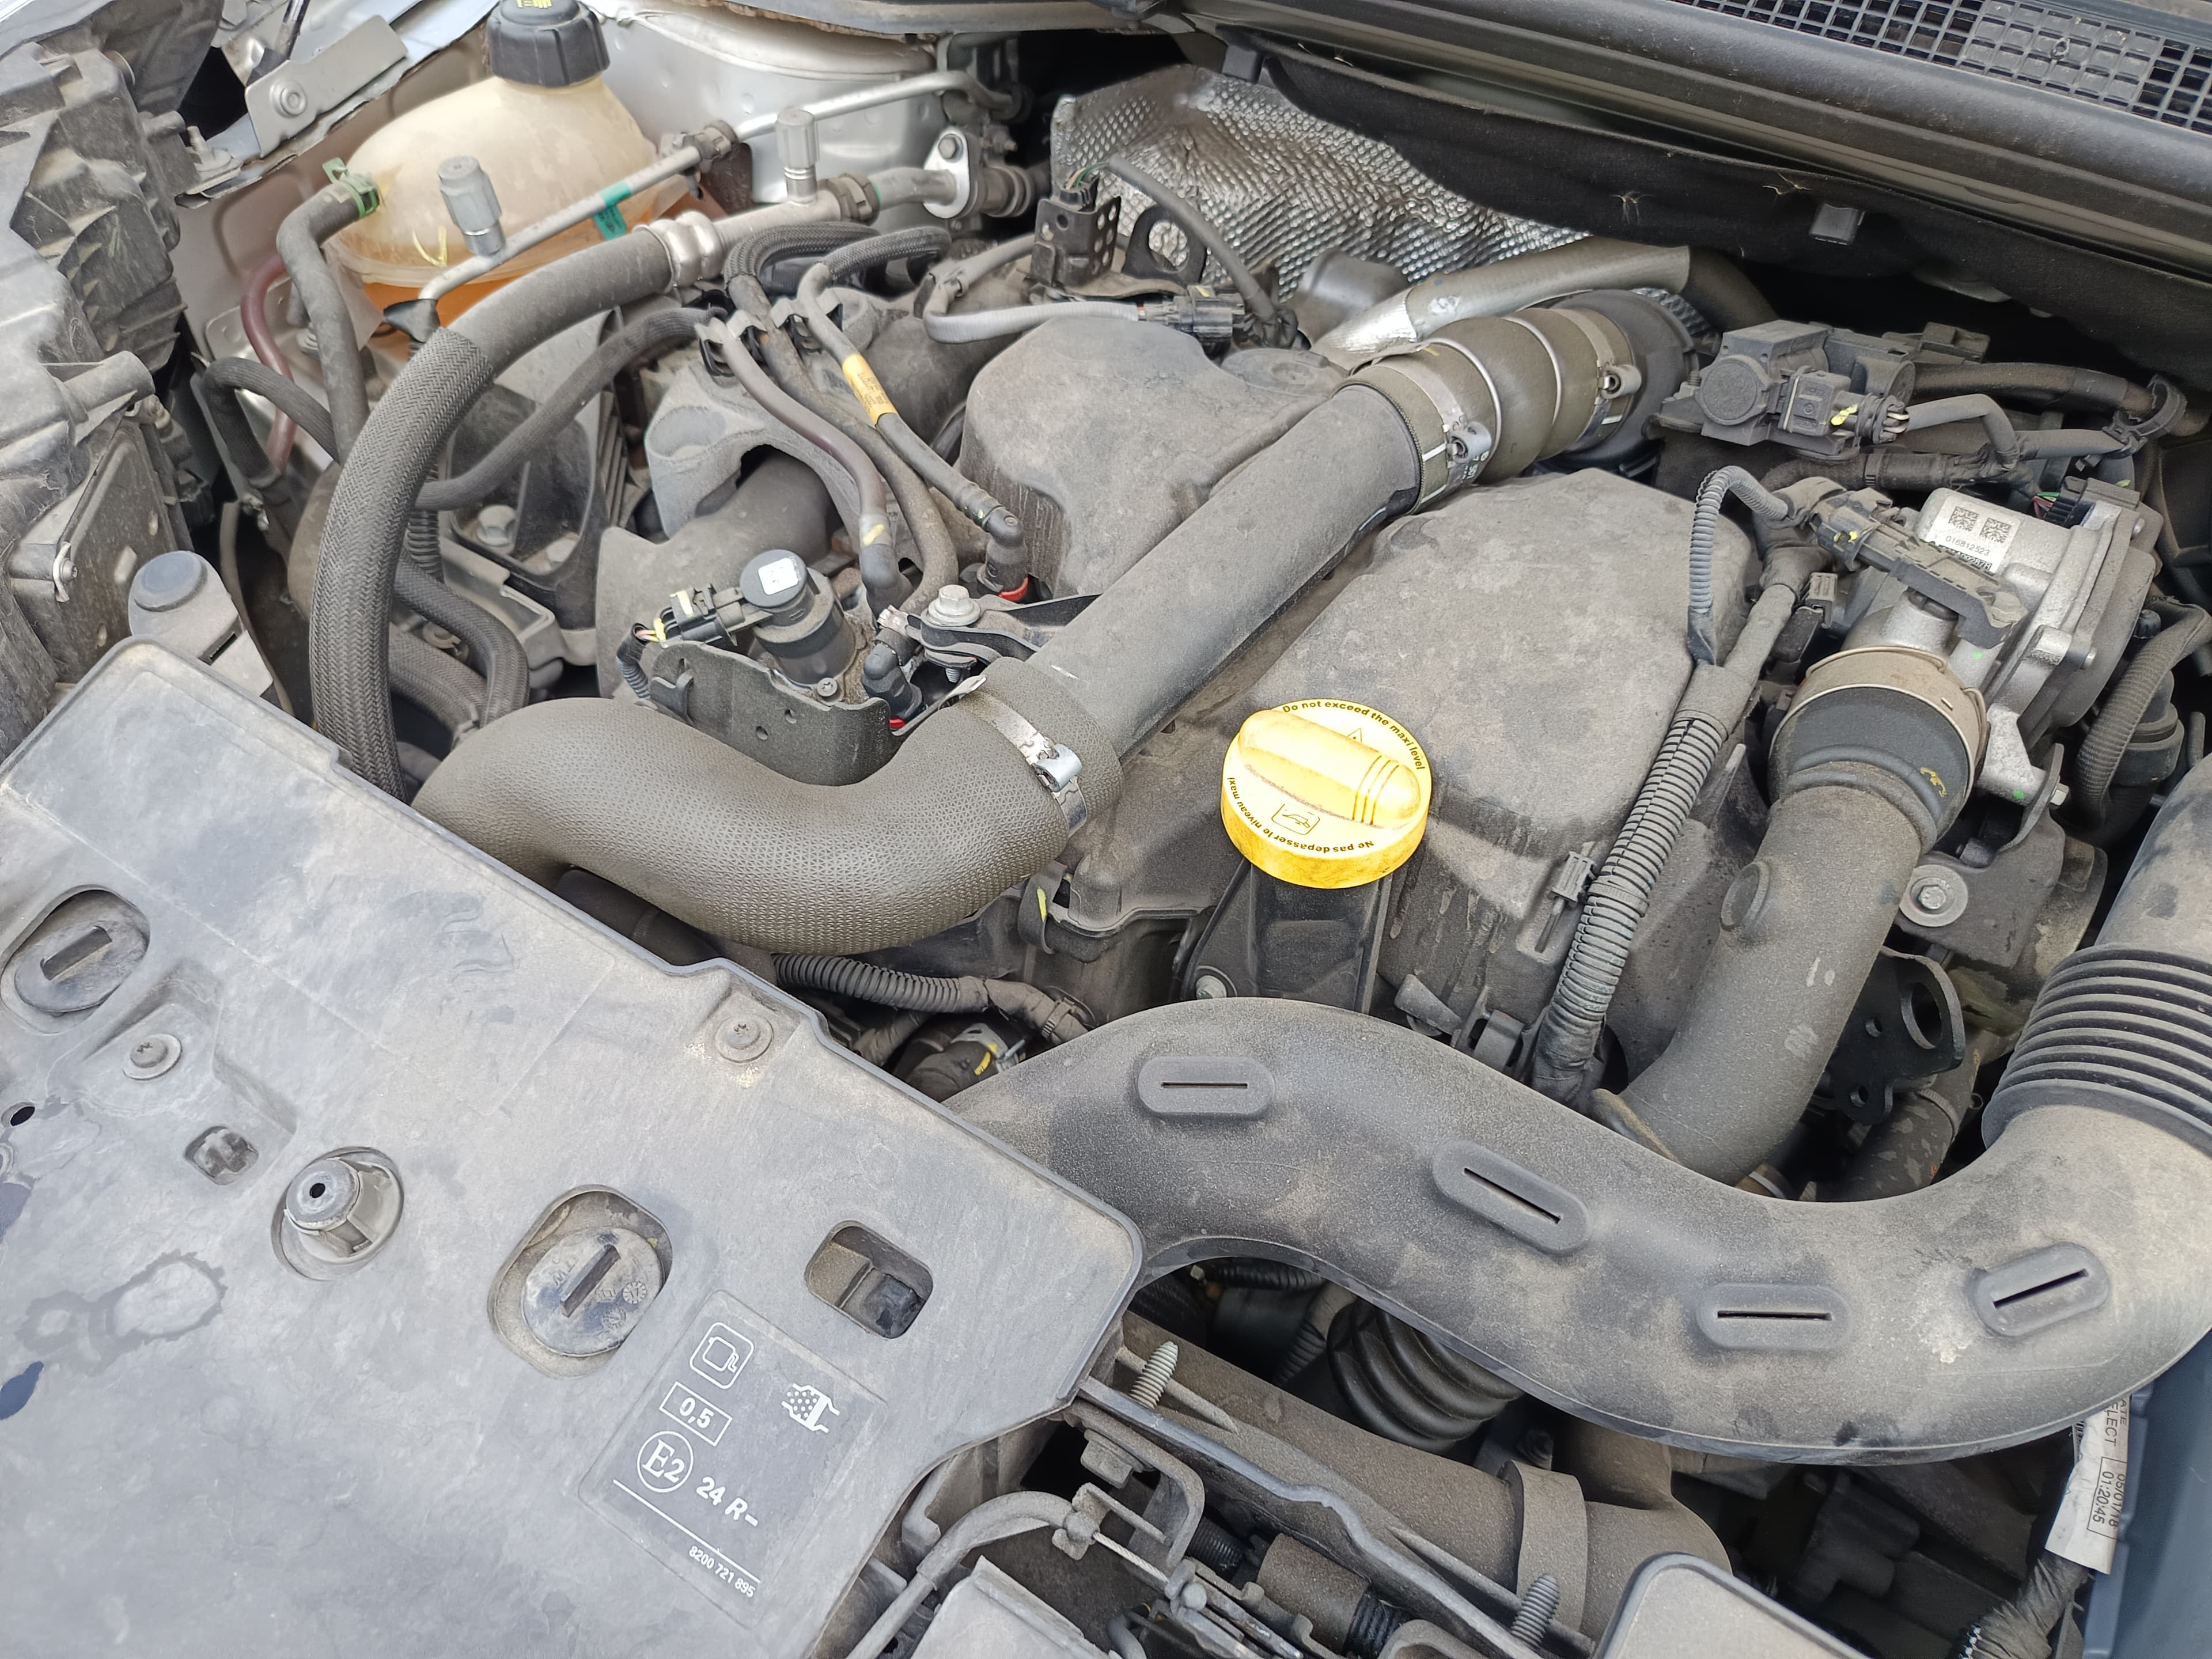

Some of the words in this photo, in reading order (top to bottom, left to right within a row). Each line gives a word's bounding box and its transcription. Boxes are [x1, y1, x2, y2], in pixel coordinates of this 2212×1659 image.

[1945, 535, 1990, 556] 016812523
[1282, 704, 1298, 713] Do
[1301, 700, 1321, 709] not
[1324, 702, 1370, 716] exceed
[1370, 712, 1389, 726] the
[1389, 725, 1414, 747] maxi
[1409, 747, 1426, 770] level
[1228, 777, 1240, 799] maxi
[1237, 801, 1262, 828] niveau
[1263, 828, 1274, 838] le
[1358, 840, 1375, 849] Ne
[1333, 843, 1354, 853] pas
[680, 1397, 715, 1428] 0,5
[642, 1439, 685, 1483] E2
[696, 1476, 726, 1506] 24
[2092, 1471, 2115, 1524] 01:20:45
[2108, 1473, 2125, 1527] 05/01/18
[688, 1546, 715, 1570] 8200
[715, 1563, 734, 1584] 721
[734, 1577, 756, 1597] 895
